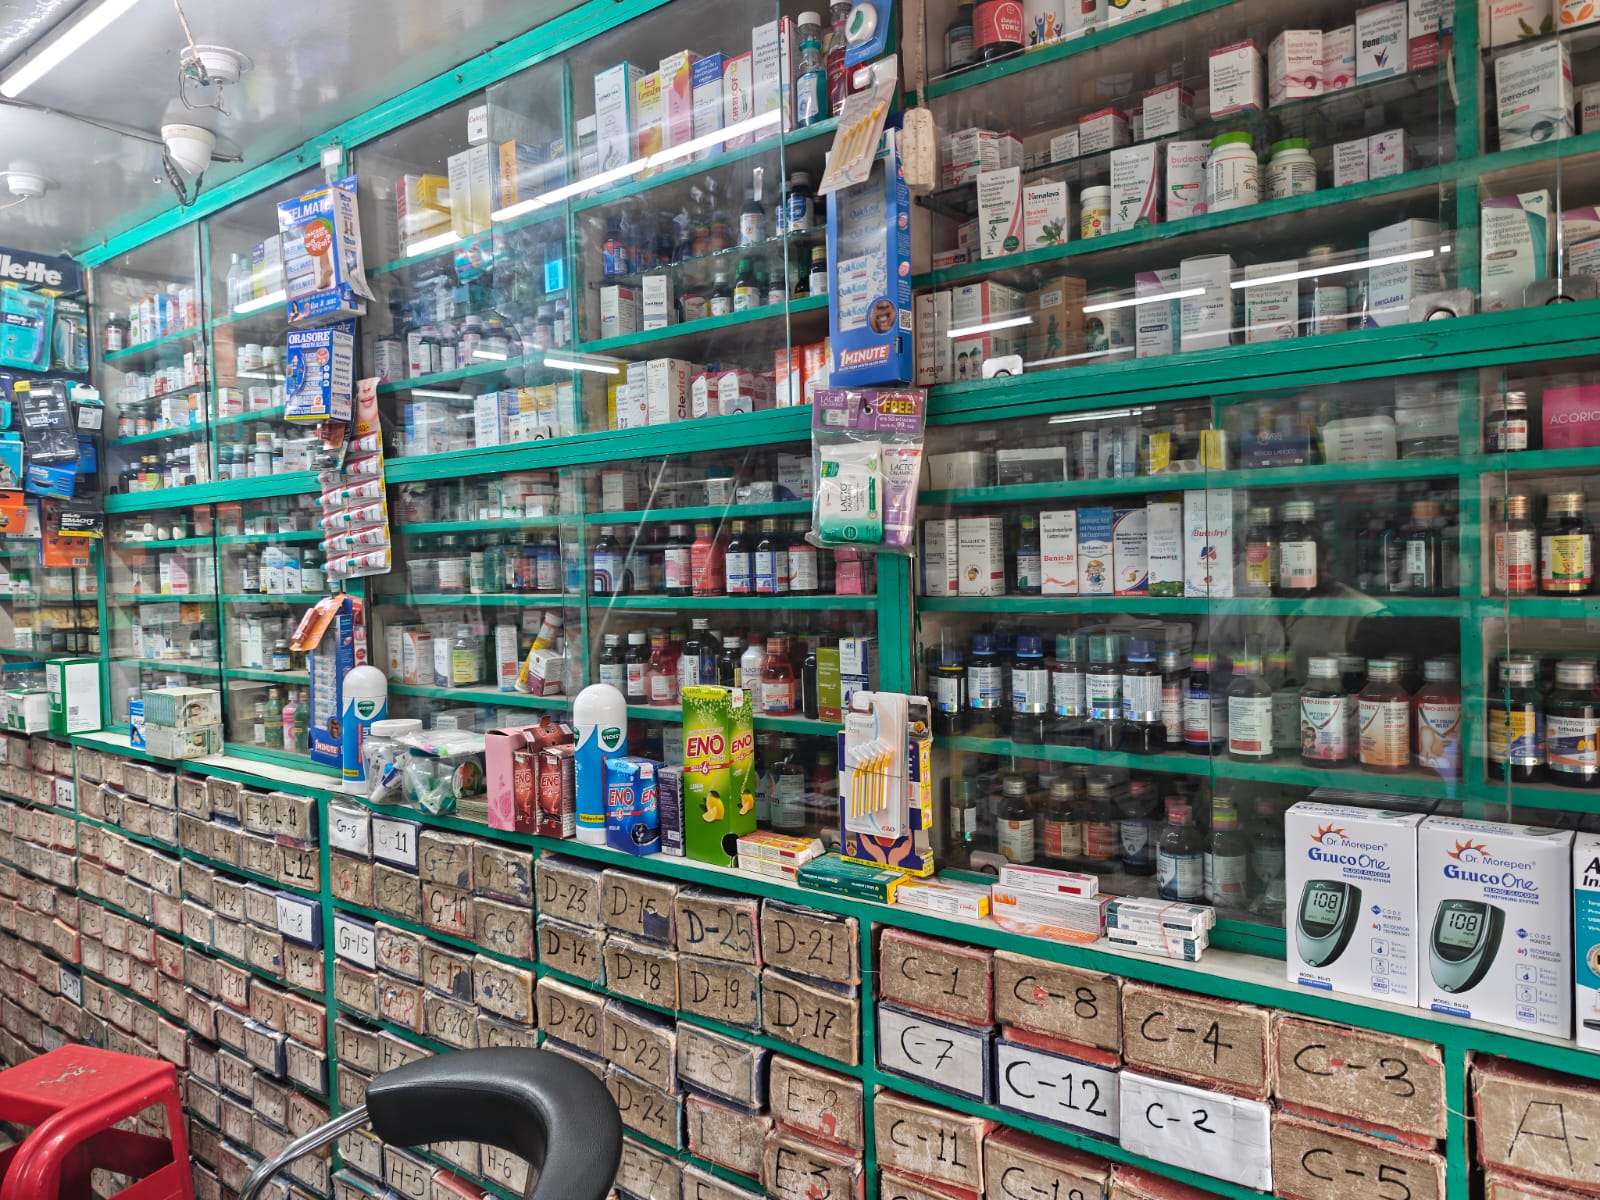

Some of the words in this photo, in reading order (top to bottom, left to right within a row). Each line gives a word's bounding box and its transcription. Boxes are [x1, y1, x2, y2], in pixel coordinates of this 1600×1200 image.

[1501, 86, 1540, 104] aerocort
[0, 254, 62, 286] lette
[289, 332, 329, 344] ORASORE
[839, 343, 889, 368] 1MINUTE
[678, 370, 687, 418] Clevira
[883, 400, 916, 414] FREE!
[1550, 410, 1600, 425] ACORIC
[686, 734, 724, 757] ENO
[730, 734, 752, 754] ENO
[608, 788, 634, 806] ENO
[641, 789, 656, 804] EN
[274, 802, 297, 826] L-11
[337, 819, 357, 838] G-8
[424, 845, 455, 871] G-7
[1326, 837, 1338, 845] Dr.
[1341, 839, 1384, 852] Morepen
[283, 851, 314, 880] L-12
[1358, 854, 1390, 870] One
[1465, 854, 1477, 863] Dr.
[1482, 857, 1532, 870] Morepen
[544, 875, 588, 914] D-23
[1502, 872, 1538, 892] One
[429, 889, 467, 927] G-10
[612, 886, 656, 924] D-15
[1313, 892, 1337, 910] 108
[279, 904, 303, 932] M-8
[483, 914, 517, 945] G-6
[682, 908, 753, 952] D-25
[1449, 912, 1478, 932] 108
[338, 926, 369, 956] G-15
[547, 929, 588, 967] D-14
[774, 919, 834, 965] D-21
[290, 951, 314, 978] M-9
[616, 953, 661, 991] D-18
[900, 956, 969, 1000] C-1
[220, 969, 243, 998] M-10
[692, 970, 739, 1009] D-19
[1013, 975, 1099, 1020] C-8
[286, 1003, 319, 1035] M-18
[434, 1005, 470, 1039] G-20
[549, 996, 597, 1039] D-20
[773, 990, 837, 1040] D-17
[612, 1023, 661, 1074] D-22
[900, 1025, 954, 1070] C-7
[1140, 1012, 1233, 1065] C-4
[222, 1058, 245, 1087] M-11
[1293, 1043, 1417, 1099] C-3
[615, 1081, 668, 1125] D-24
[1004, 1060, 1108, 1117] C-12
[1145, 1102, 1217, 1135] C-2
[890, 1119, 968, 1170] C-11
[1508, 1100, 1600, 1172] A-
[391, 1158, 425, 1196] H-5
[487, 1146, 512, 1179] H-6
[1300, 1148, 1413, 1200] C-5
